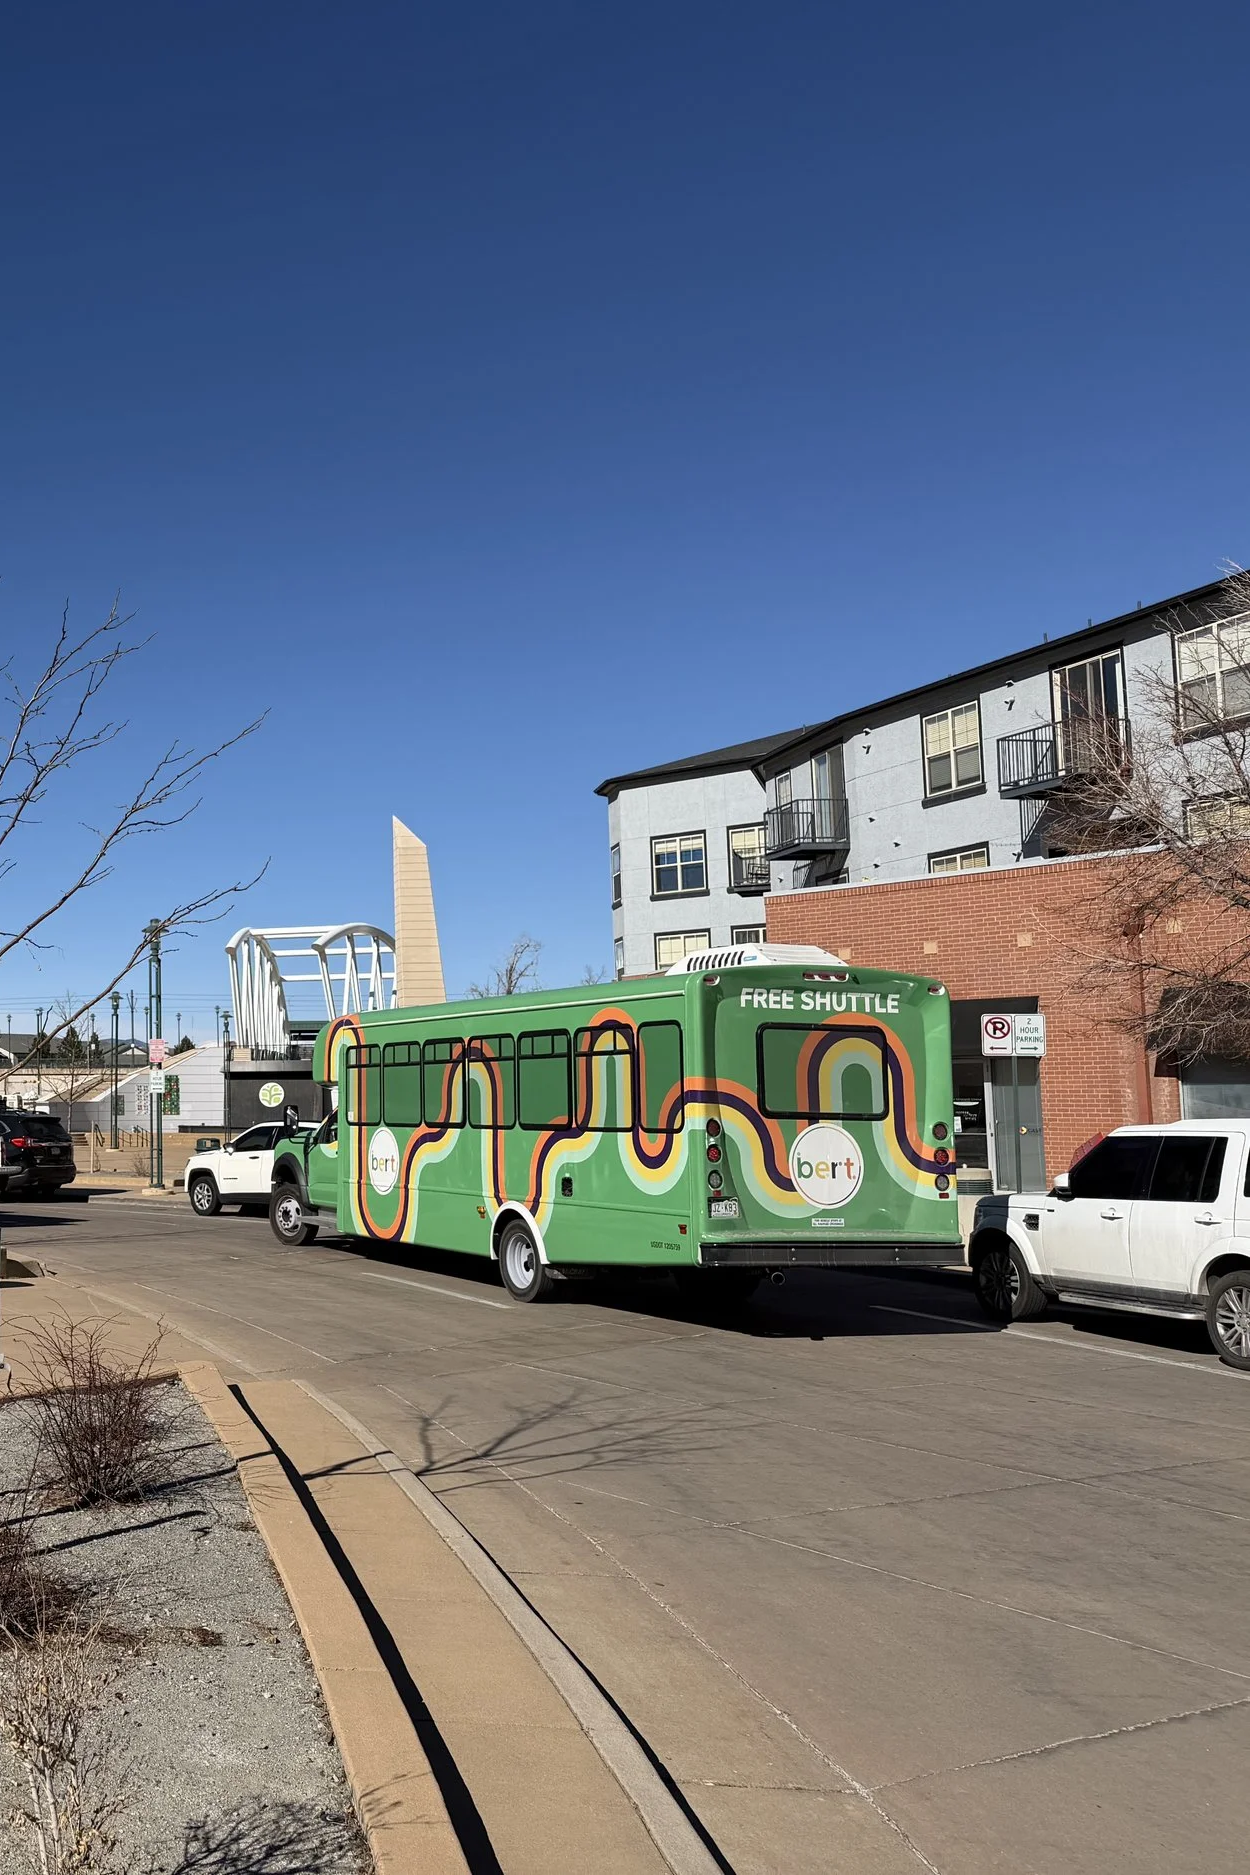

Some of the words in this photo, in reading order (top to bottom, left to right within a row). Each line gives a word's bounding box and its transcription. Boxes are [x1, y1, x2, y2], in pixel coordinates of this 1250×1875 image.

[740, 987, 795, 1010] FREE
[800, 990, 900, 1014] SHUTTLE
[1026, 1017, 1032, 1025] 2
[1019, 1026, 1039, 1034] HOUR
[1016, 1035, 1044, 1043] PARKING
[371, 1153, 396, 1172] bert
[796, 1155, 855, 1180] bert
